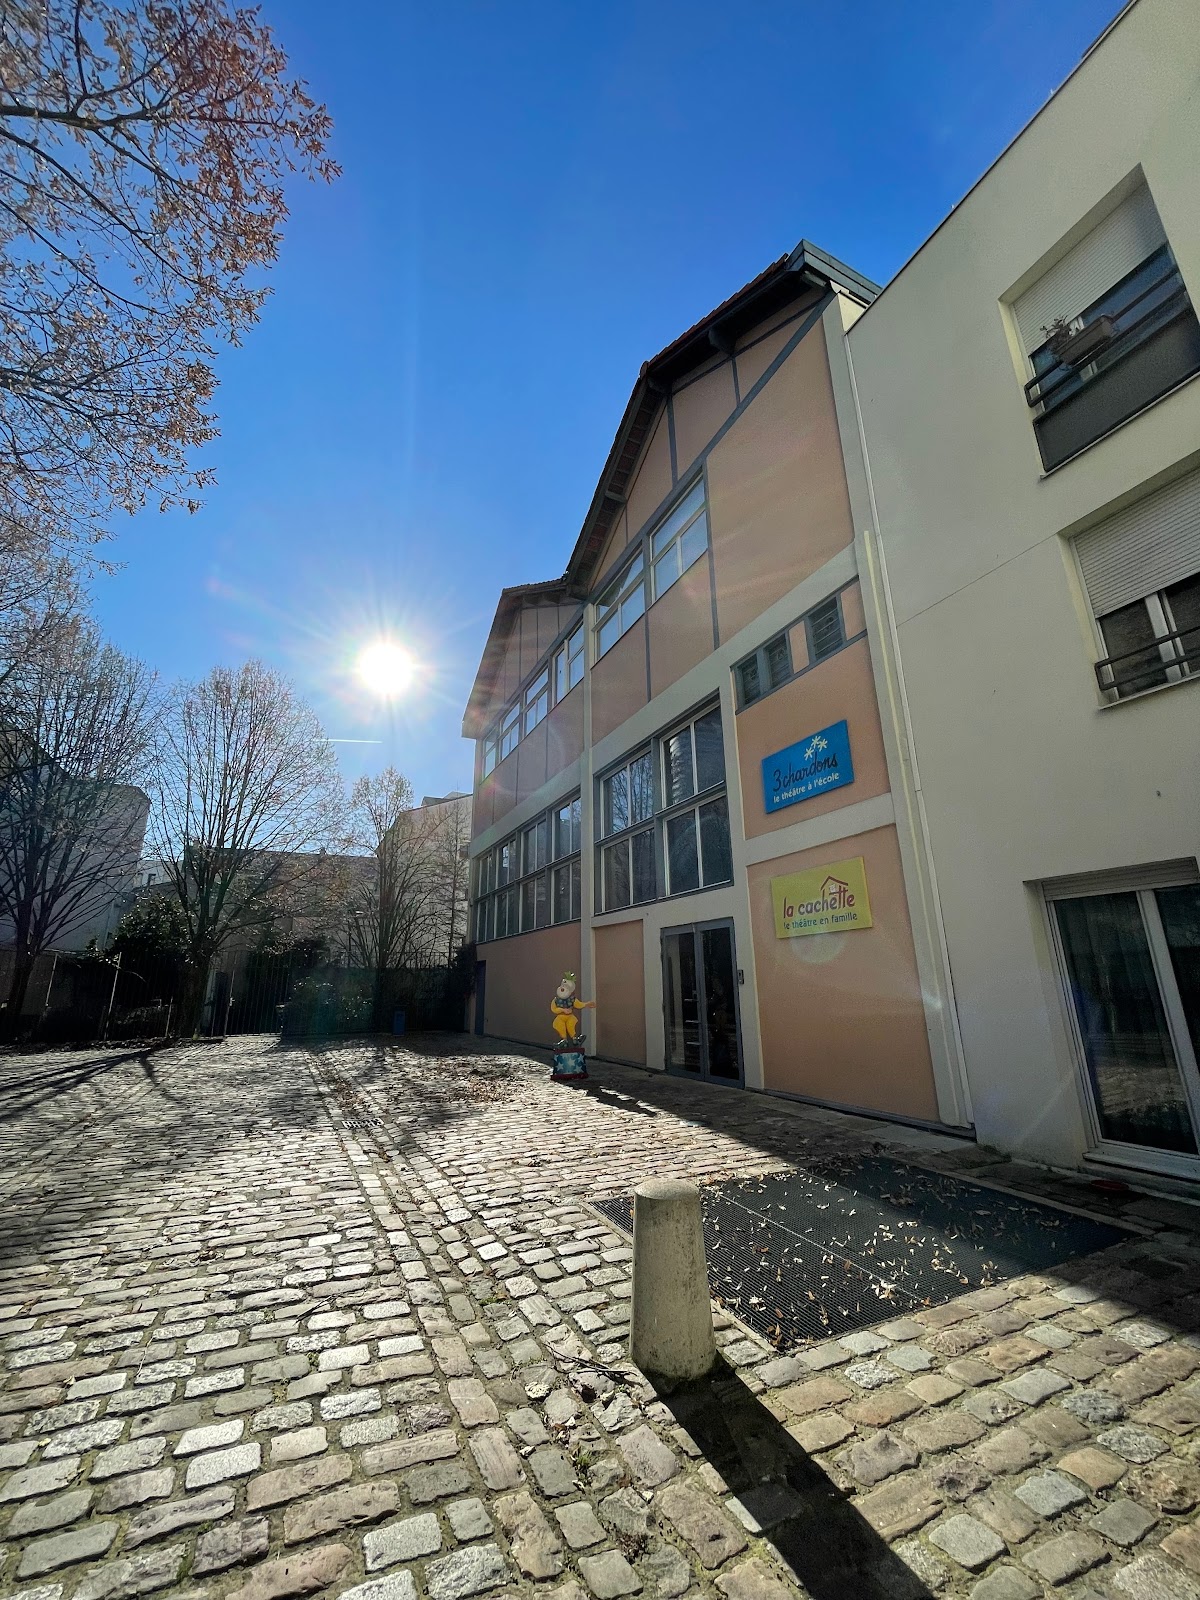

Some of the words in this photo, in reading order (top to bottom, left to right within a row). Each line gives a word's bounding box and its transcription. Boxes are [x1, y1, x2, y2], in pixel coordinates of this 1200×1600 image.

[773, 795, 780, 803] le
[781, 786, 806, 800] théâtre
[807, 781, 813, 790] à
[813, 772, 840, 788] l'école
[783, 897, 795, 919] la
[797, 885, 856, 916] cachette
[783, 921, 790, 930] le
[792, 918, 818, 929] théâtre
[820, 916, 829, 925] en
[831, 911, 858, 924] famille
